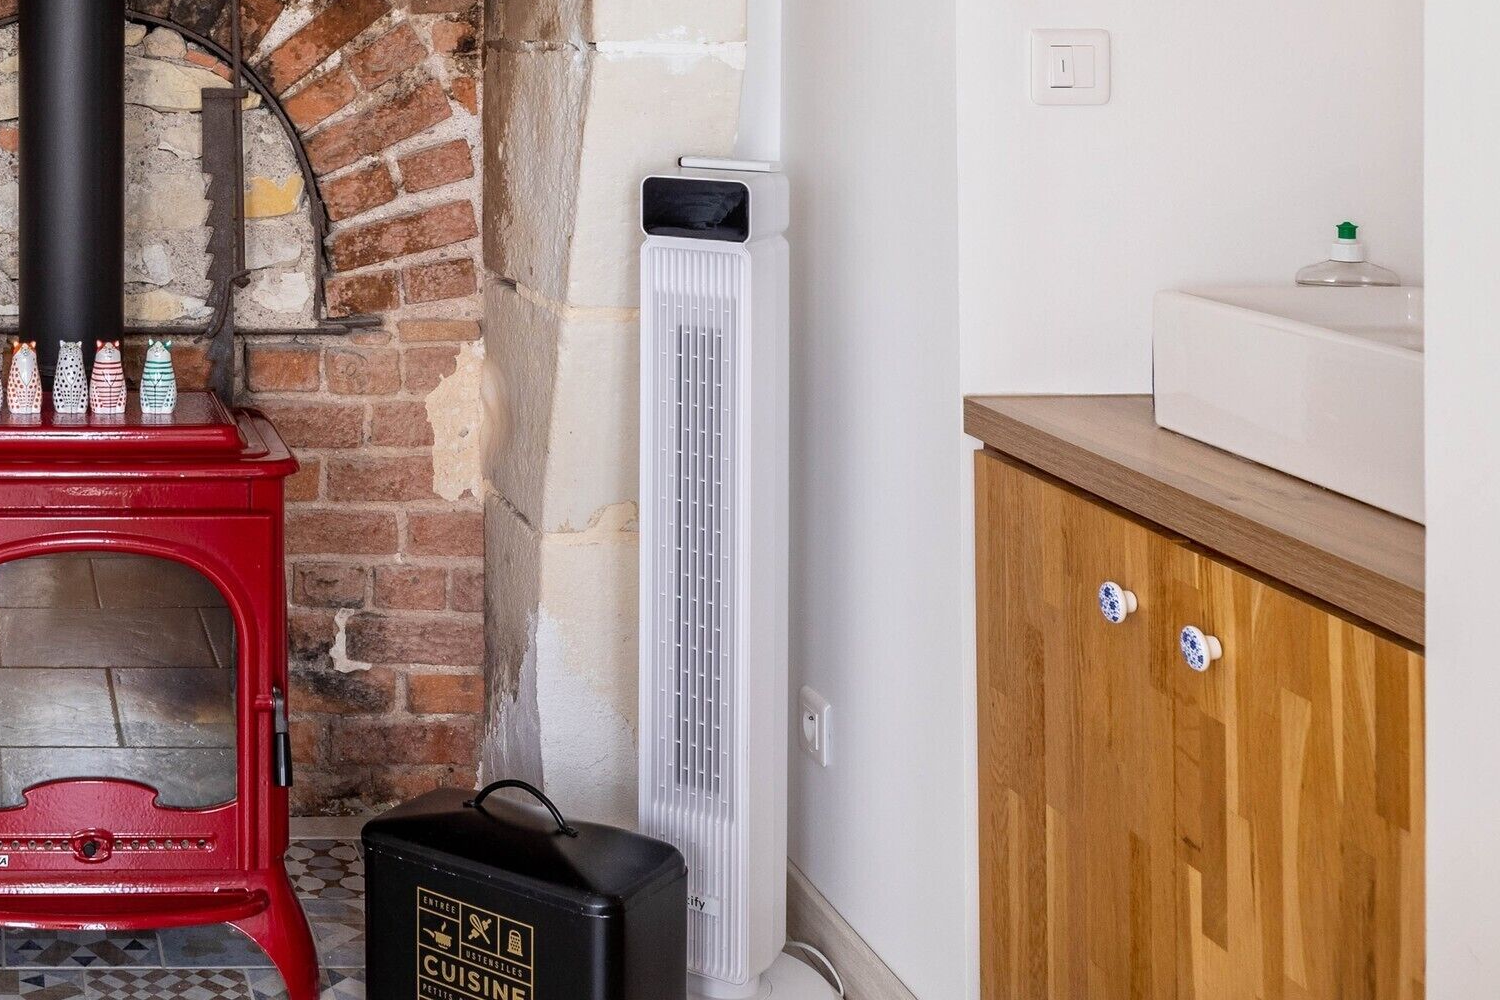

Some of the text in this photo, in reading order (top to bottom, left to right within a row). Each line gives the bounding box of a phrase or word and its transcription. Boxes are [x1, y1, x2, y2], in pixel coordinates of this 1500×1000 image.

[423, 896, 456, 914] ENTRÉE
[424, 955, 525, 1000] CUISINE
[466, 950, 523, 978] USTENSILES
